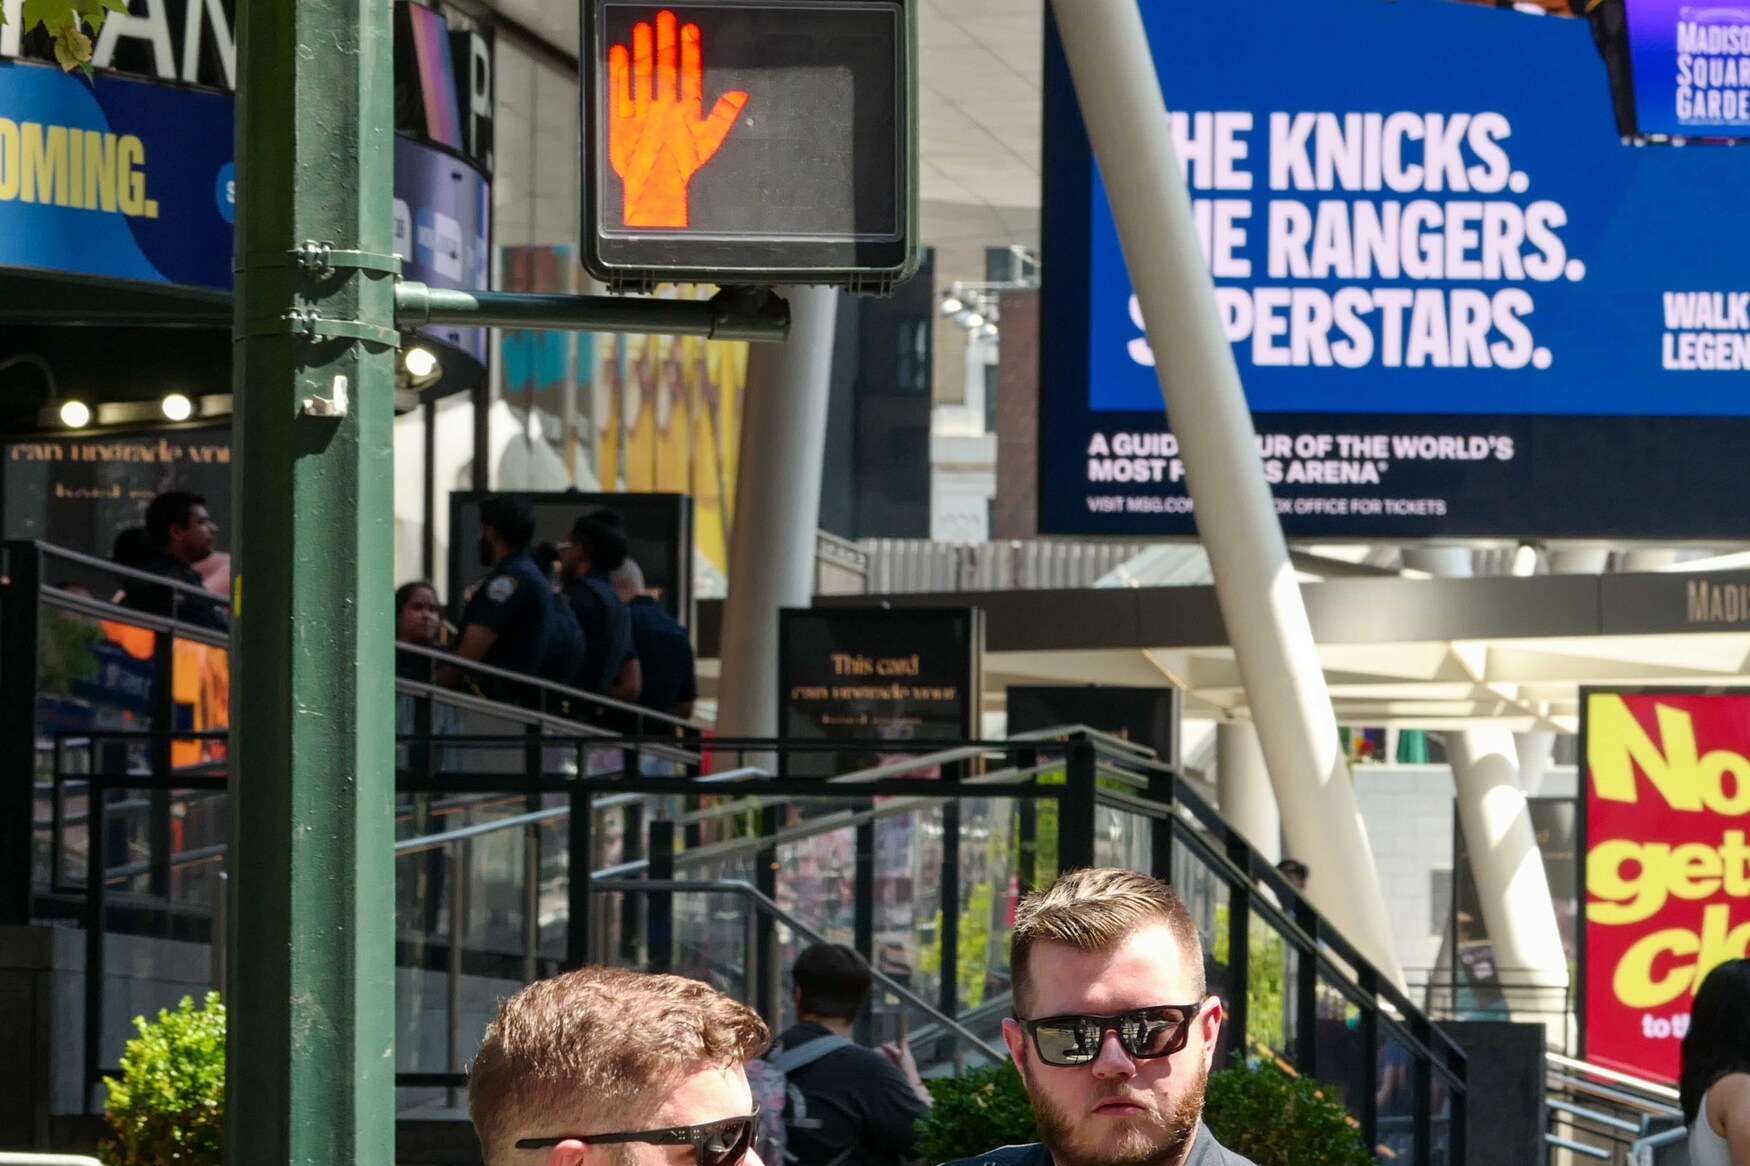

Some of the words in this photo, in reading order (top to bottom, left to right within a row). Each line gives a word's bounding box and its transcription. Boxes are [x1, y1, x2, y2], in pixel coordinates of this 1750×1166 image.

[1168, 111, 1253, 190] HE
[1269, 111, 1530, 193] KNICKS.
[1268, 199, 1586, 282] RANGERS.
[1127, 286, 1553, 369] PERSTARS.
[1663, 292, 1750, 329] WALK
[1087, 432, 1110, 456] A
[1112, 432, 1179, 456] GUID
[1255, 434, 1293, 458] UR
[1295, 435, 1333, 458] OF
[1335, 435, 1389, 459] THE
[1391, 436, 1515, 460] WORLD'S
[1088, 458, 1167, 482] MOST
[1086, 496, 1124, 513] VISIT
[1272, 498, 1293, 514] OX
[1295, 498, 1348, 514] OFFICE
[1351, 499, 1383, 514] FOR
[1384, 499, 1447, 516] TICKETS
